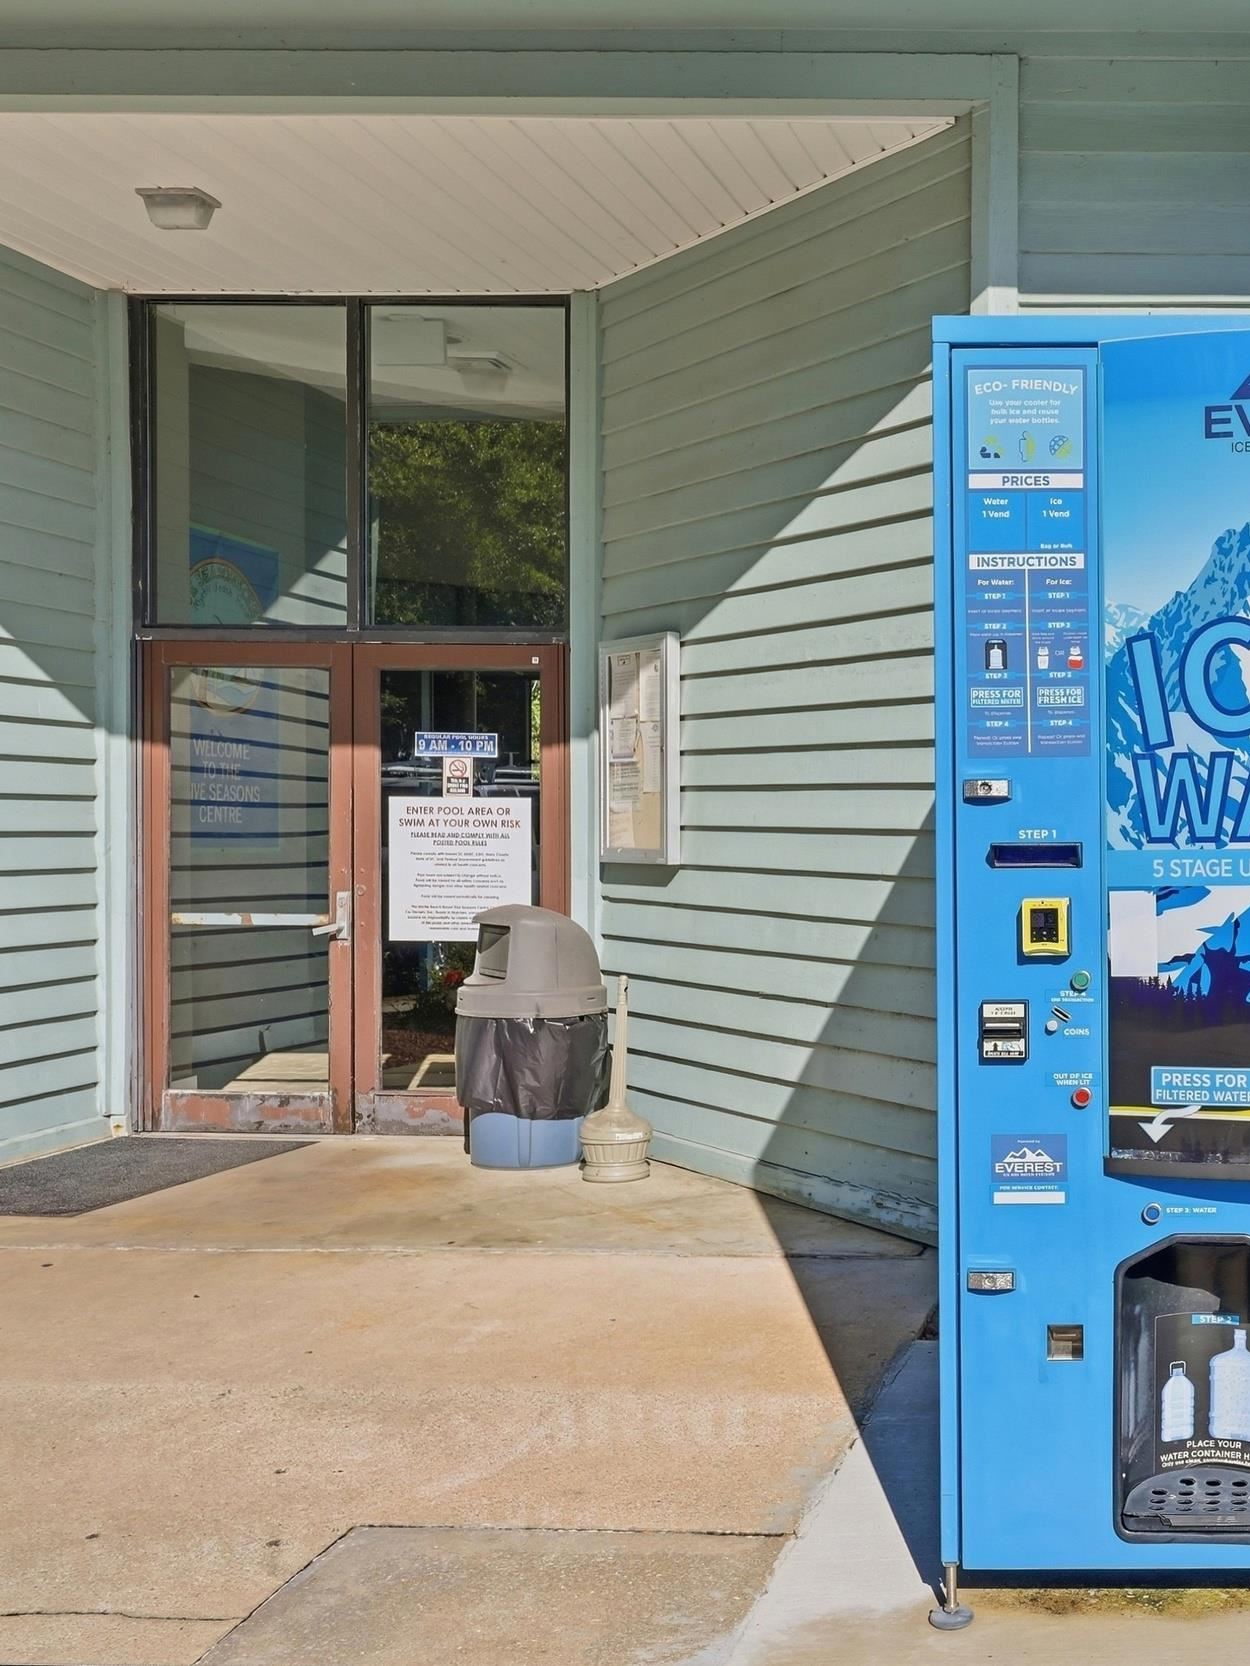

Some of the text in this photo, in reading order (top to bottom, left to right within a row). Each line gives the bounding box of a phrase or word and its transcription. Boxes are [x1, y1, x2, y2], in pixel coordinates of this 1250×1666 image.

[1012, 379, 1078, 395] FRIENDLY
[1002, 476, 1050, 486] PRICES
[976, 556, 1077, 568] INSTRUCTIONS
[1038, 696, 1068, 704] FRESH
[193, 738, 250, 760] WELCOME
[418, 740, 494, 752] 9 AM 10 PM
[203, 760, 241, 780] TO THE
[209, 783, 260, 802] SEASONS
[200, 806, 242, 824] CENTRE
[406, 806, 510, 816] ENTER POOL AREA OR
[399, 818, 521, 828] SWIM AT YOUR OWN RISK
[1018, 830, 1057, 839] STEP 1
[1152, 860, 1164, 877] 5
[1170, 859, 1232, 877] STAGE
[1162, 1072, 1247, 1088] PRESS FOR
[1155, 1089, 1210, 1101] FILTERED
[995, 1163, 1063, 1173] EVEREST
[1186, 1440, 1242, 1449] PLACE YOUR
[1160, 1452, 1189, 1462] WATER
[1191, 1450, 1241, 1459] CONTAINER
